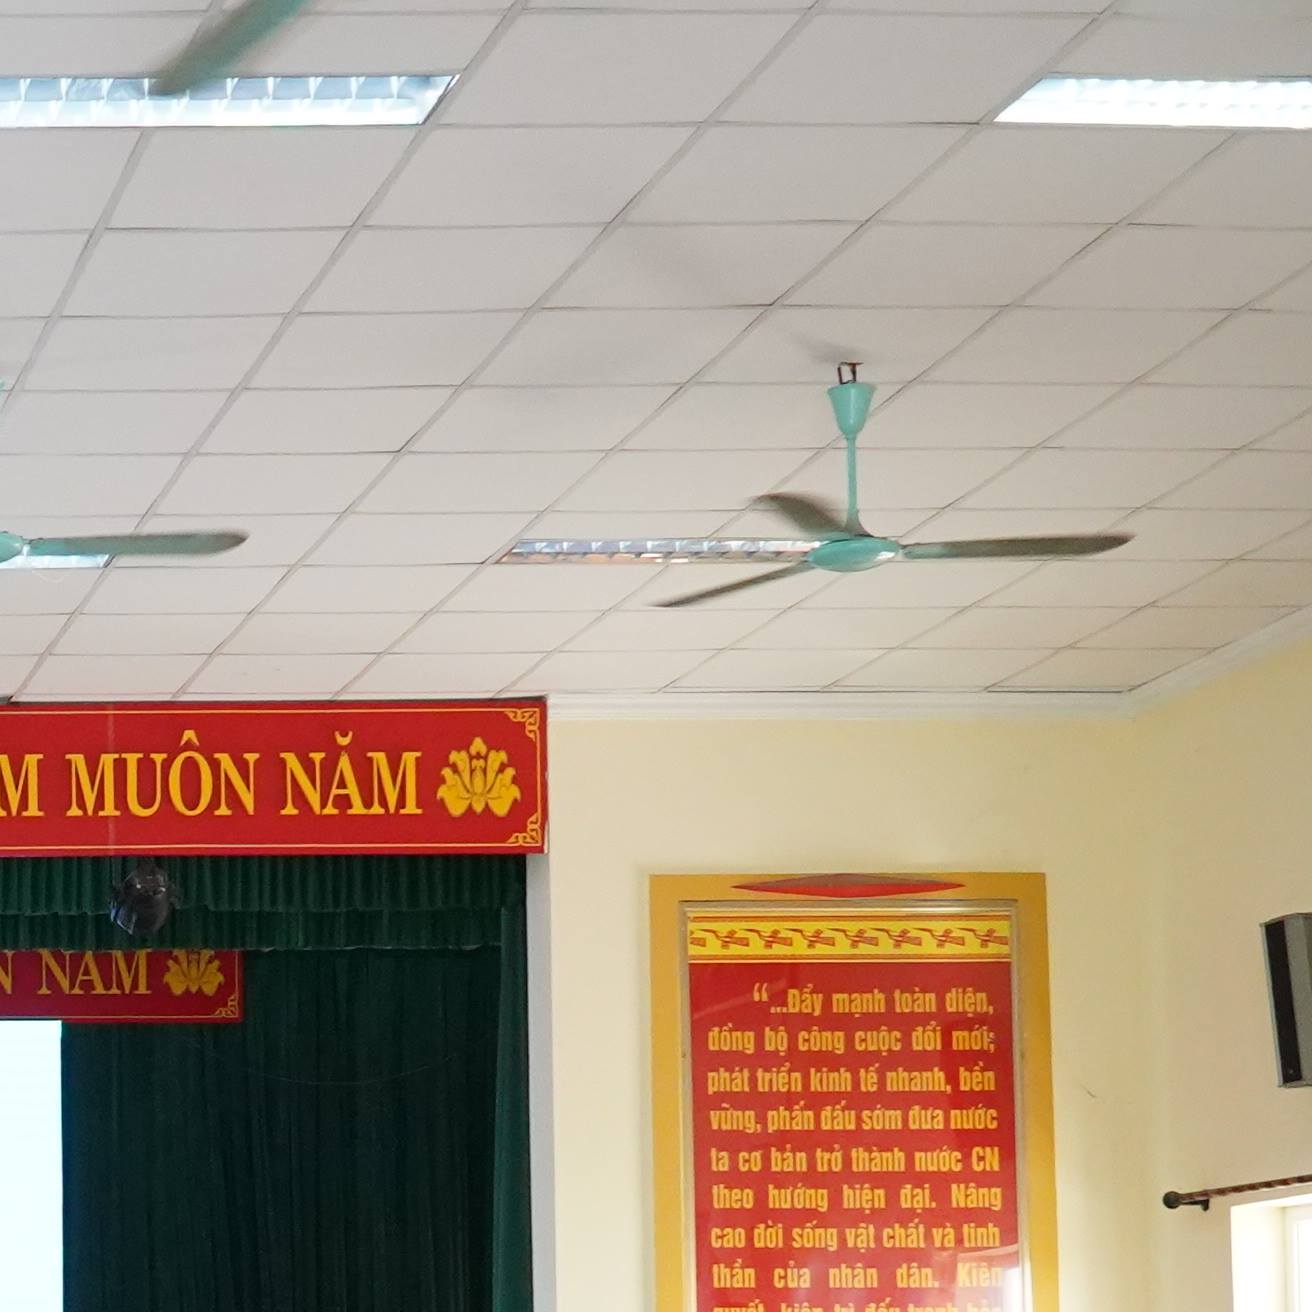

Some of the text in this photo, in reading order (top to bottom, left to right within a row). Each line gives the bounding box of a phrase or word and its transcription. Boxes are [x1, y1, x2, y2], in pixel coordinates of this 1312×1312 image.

[65, 730, 259, 818] MUÔN
[281, 730, 422, 816] NĂM
[765, 1027, 788, 1056] bộ
[798, 1027, 845, 1052] công
[708, 1067, 749, 1094] phát
[810, 1068, 852, 1092] kinh
[860, 1063, 879, 1092] tế
[886, 1067, 951, 1094] nhanh,
[820, 1100, 855, 1130] đấu
[862, 1104, 902, 1130] sớm
[908, 1106, 944, 1130] đưa
[710, 1148, 728, 1171] ta
[738, 1151, 763, 1171] cơ
[771, 1144, 807, 1171] bản
[852, 1148, 905, 1171] thành
[915, 1146, 962, 1171] nước
[972, 1147, 1000, 1171] CN
[712, 1184, 754, 1208] theo
[843, 1184, 885, 1214] hiện
[951, 1182, 1002, 1210] Nâng
